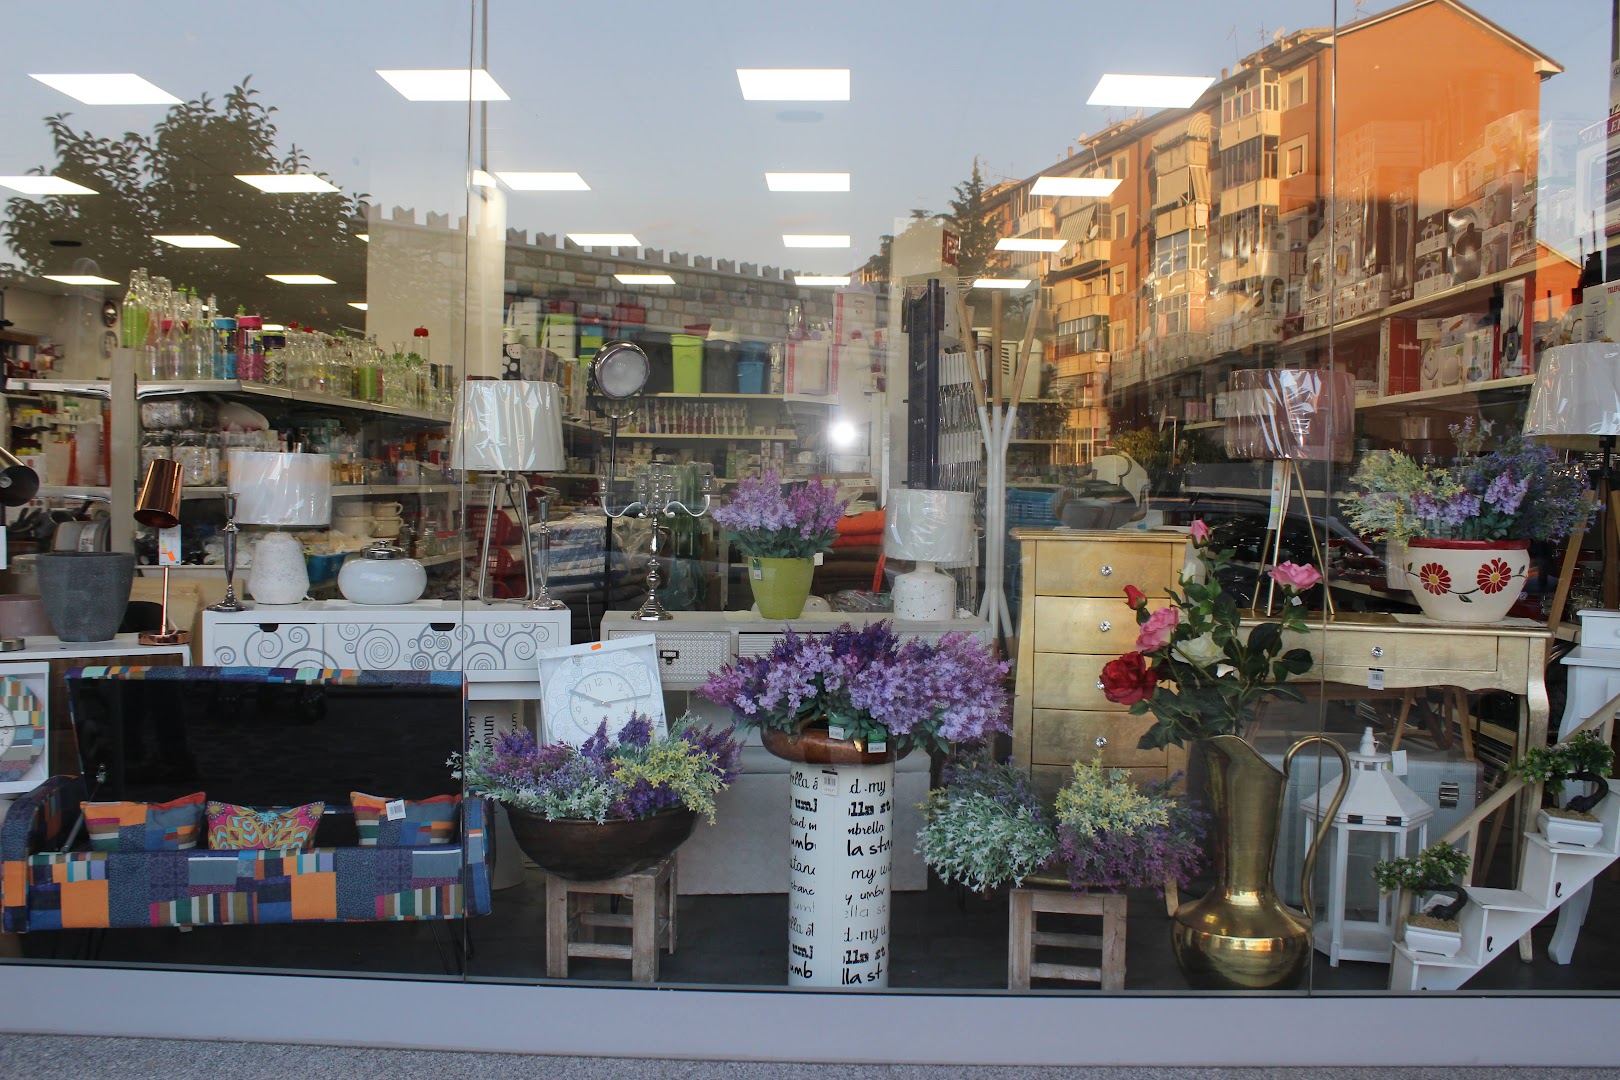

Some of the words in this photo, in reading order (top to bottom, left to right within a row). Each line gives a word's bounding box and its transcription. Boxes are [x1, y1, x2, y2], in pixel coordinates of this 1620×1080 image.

[593, 677, 603, 687] 12
[584, 683, 592, 692] 11
[617, 683, 624, 692] 2
[575, 705, 582, 715] 9
[624, 706, 630, 715] 4
[582, 716, 590, 726] 8
[616, 716, 624, 726] 5
[846, 838, 864, 857] la
[851, 868, 877, 885] my
[841, 967, 863, 985] lla
[866, 962, 883, 982] st
